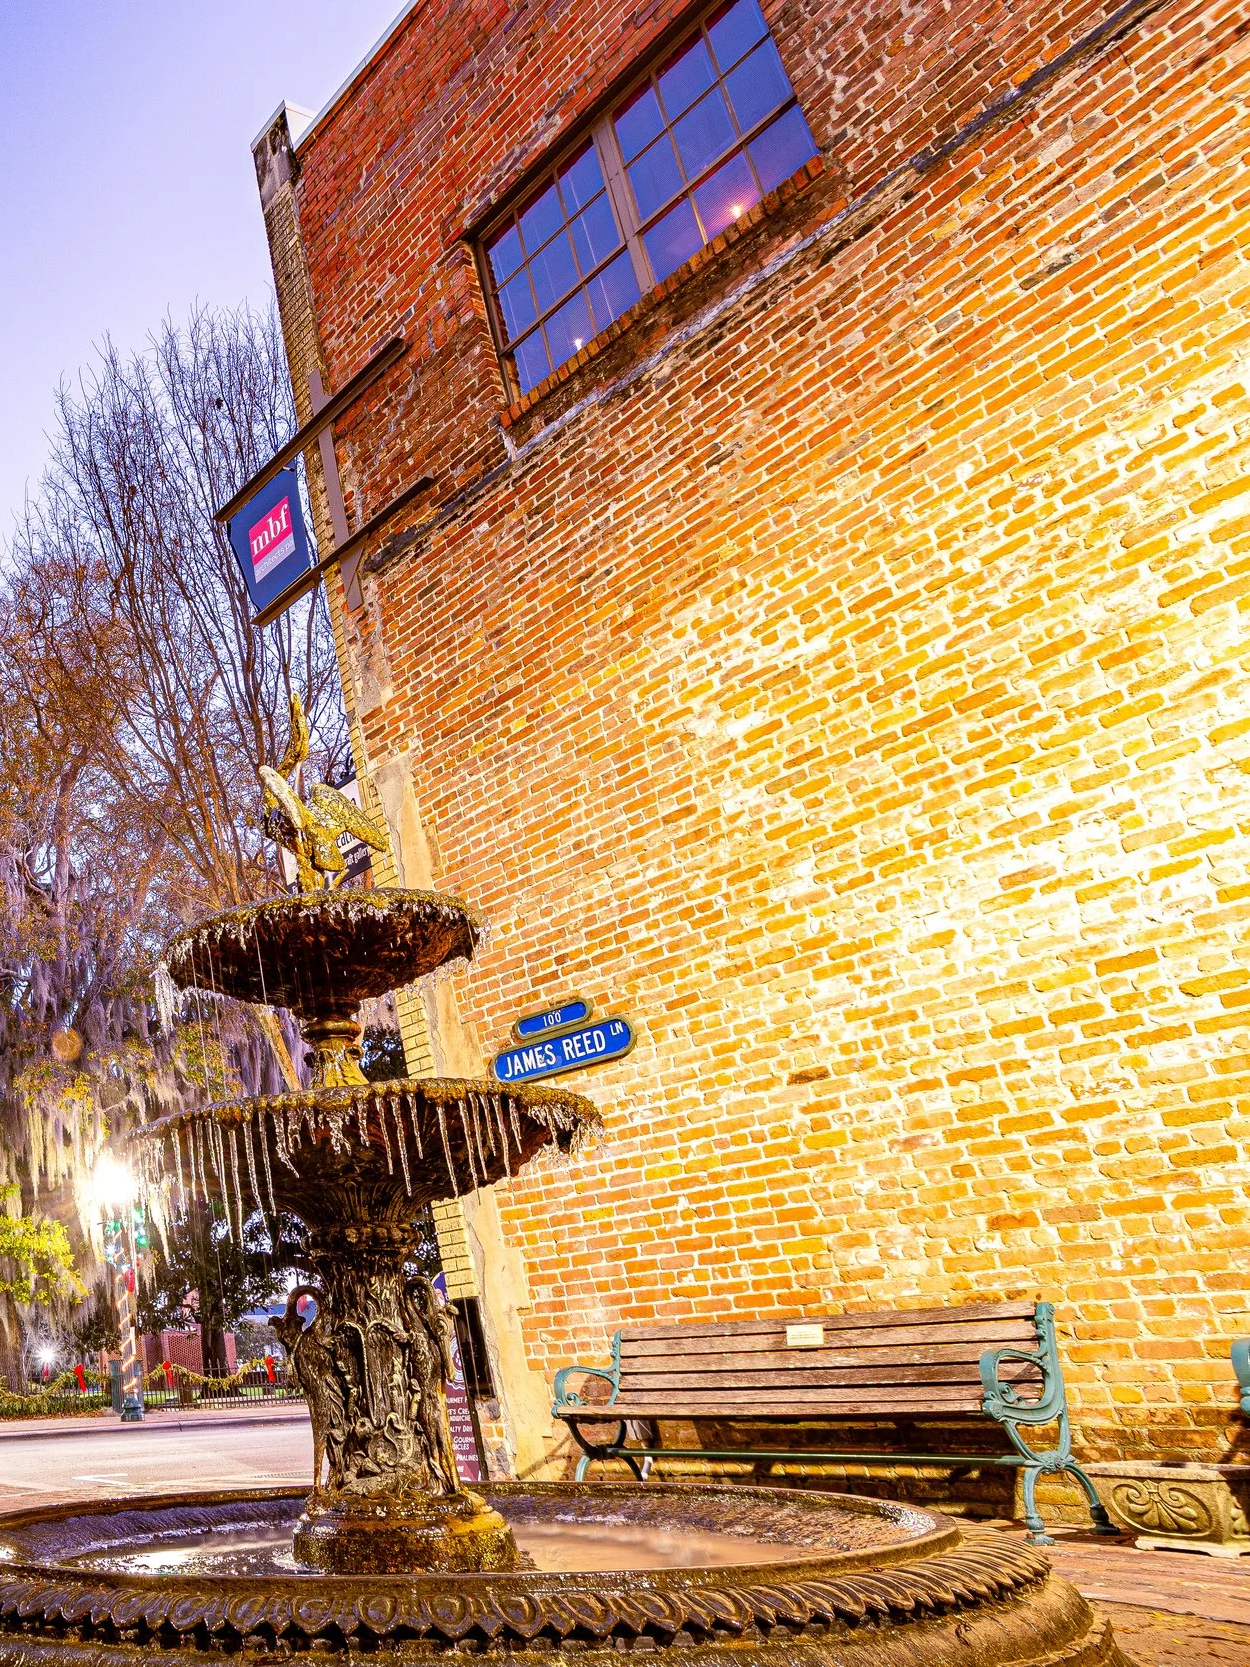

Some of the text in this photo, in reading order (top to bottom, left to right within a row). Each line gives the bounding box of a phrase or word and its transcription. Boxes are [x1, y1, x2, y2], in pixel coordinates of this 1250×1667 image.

[251, 503, 288, 557] mbf
[543, 1012, 562, 1027] 100
[504, 1021, 624, 1078] JAMES REED LN
